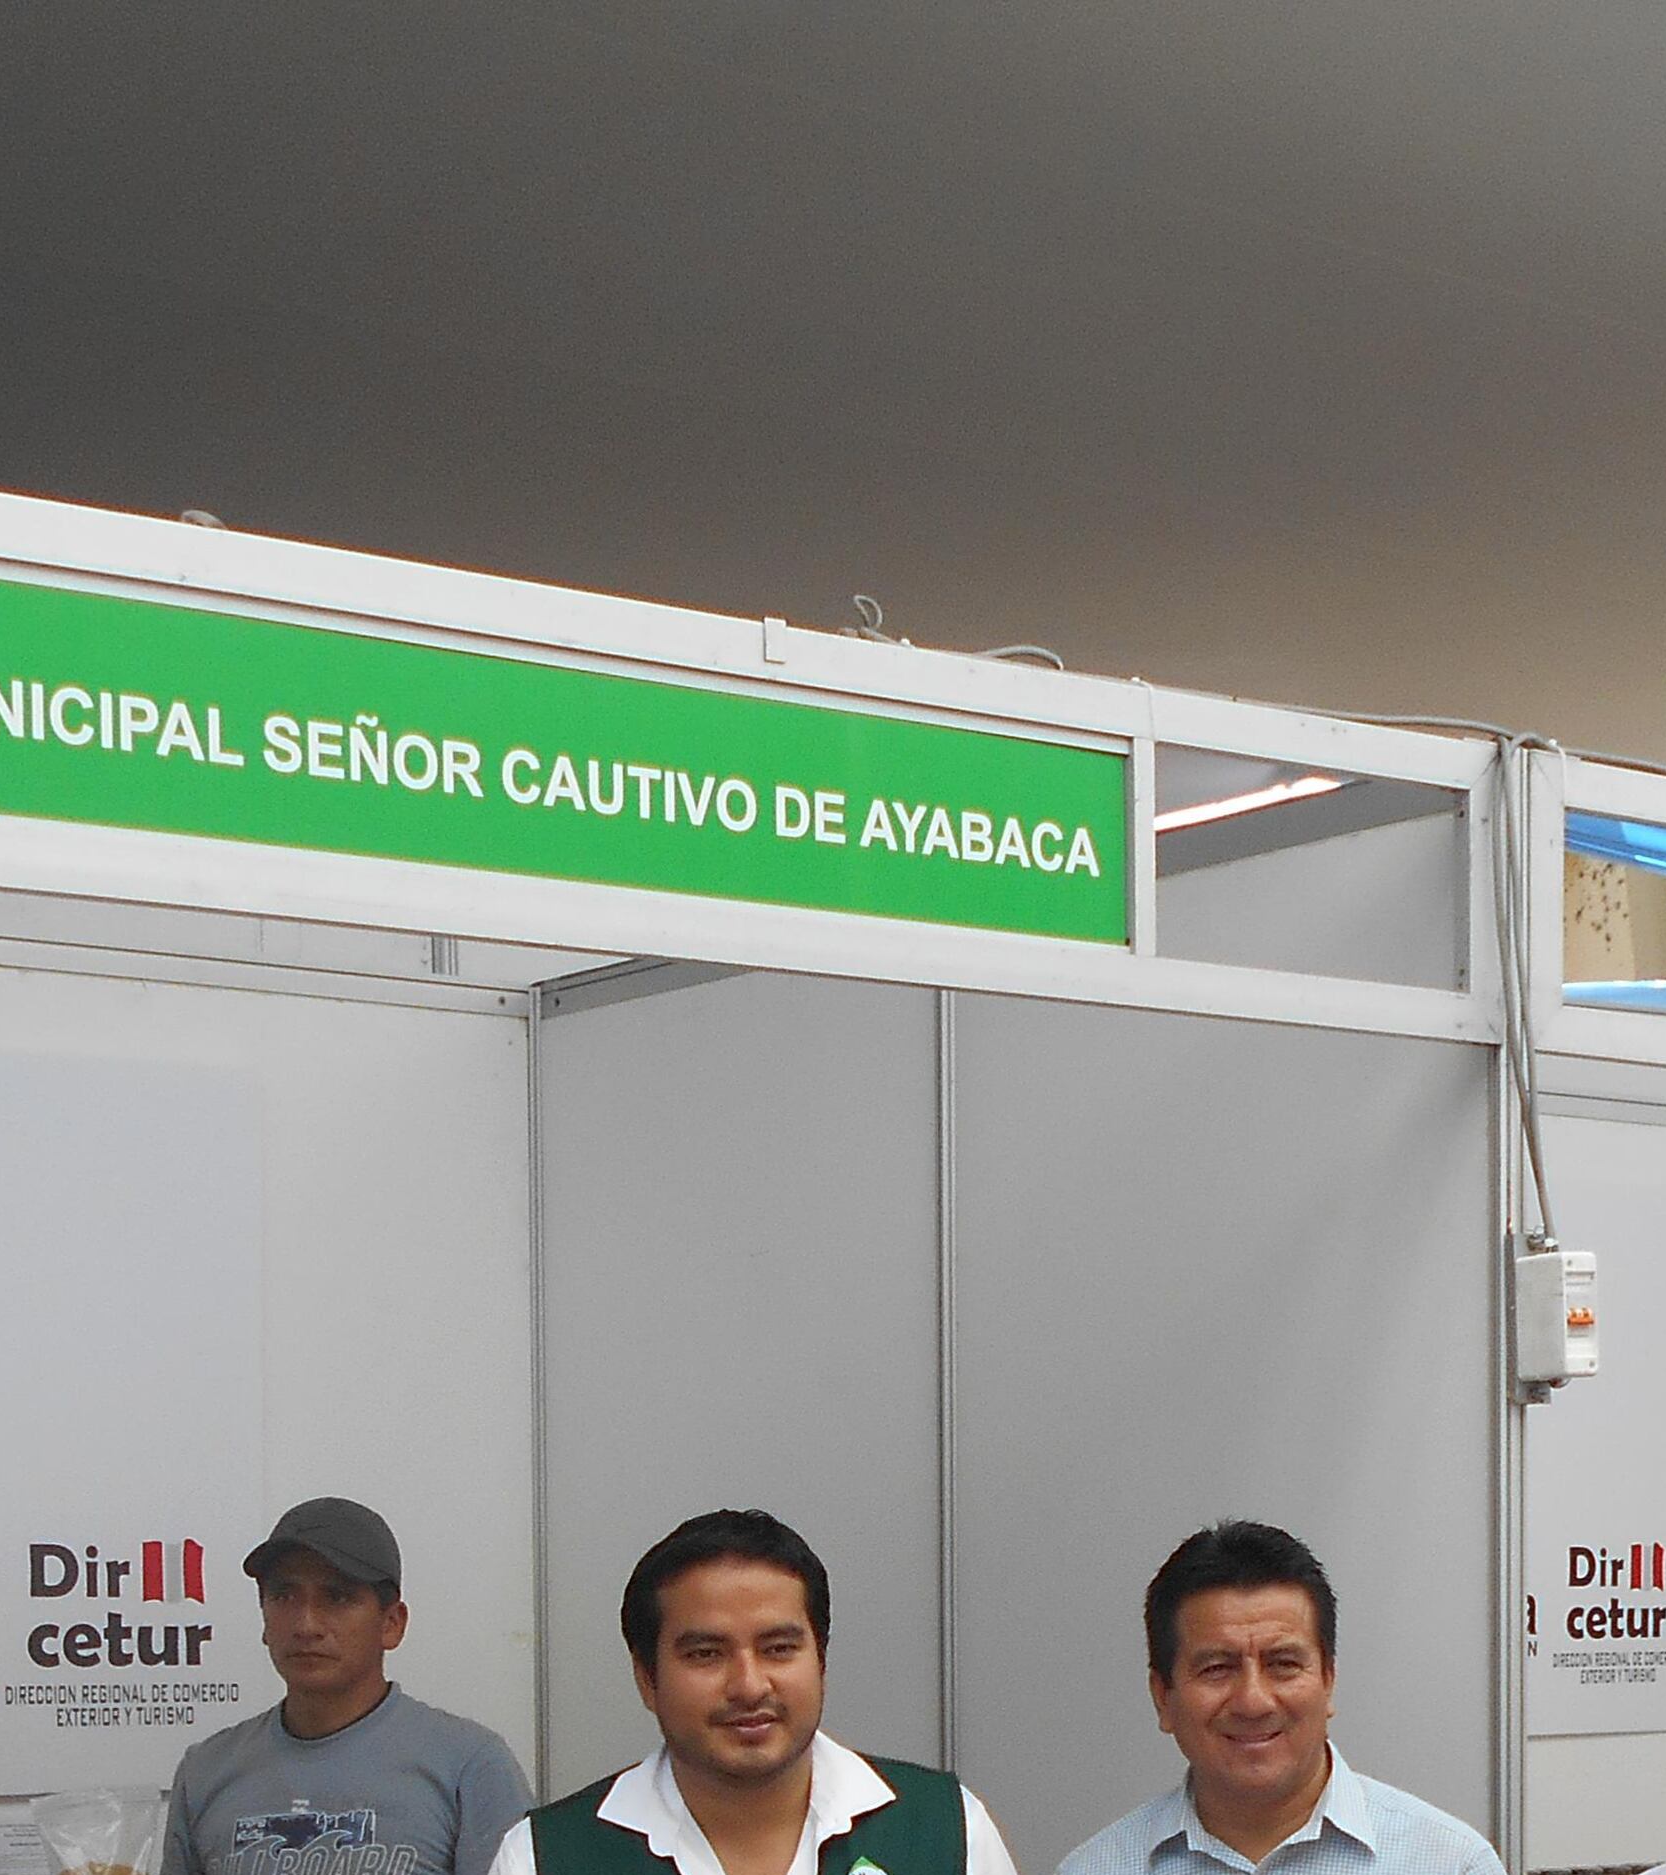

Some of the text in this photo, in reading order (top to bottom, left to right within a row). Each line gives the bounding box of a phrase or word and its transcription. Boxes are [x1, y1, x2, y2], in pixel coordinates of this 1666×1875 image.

[262, 713, 484, 799] SEÑOR
[502, 749, 758, 834] CAUTIVO
[775, 786, 847, 845] DE
[860, 801, 1100, 877] AYABACA
[29, 1543, 130, 1597] Dir
[1568, 1546, 1624, 1587] Dir
[27, 1612, 213, 1668] cetur
[4, 1683, 240, 1705] DIRECCION REGIONAL DE COMERCIO
[56, 1706, 195, 1727] EXTERIOR Y TURISMO
